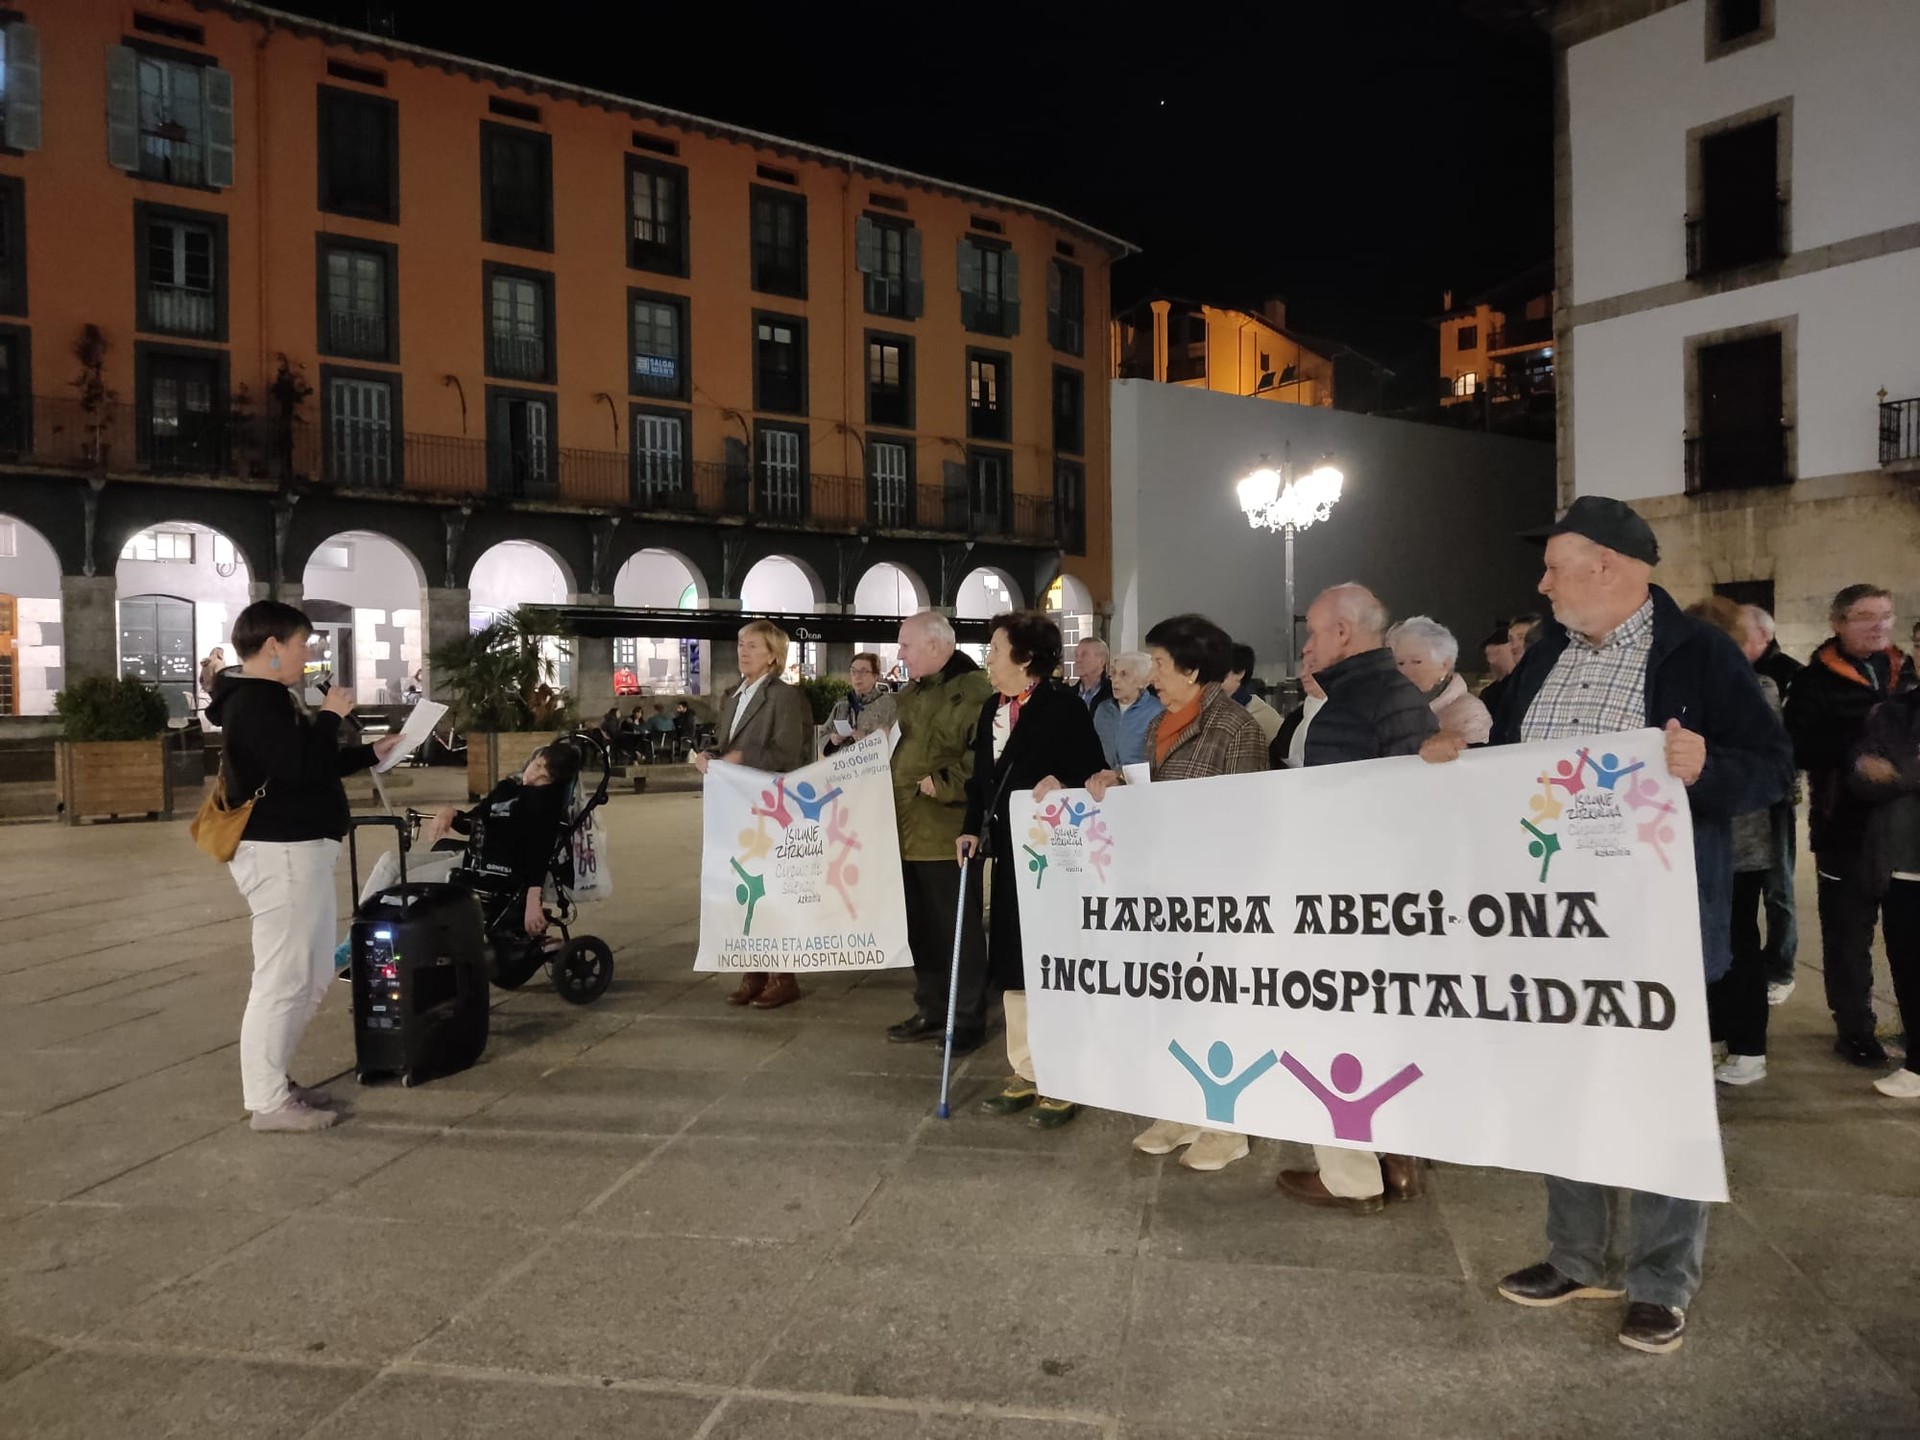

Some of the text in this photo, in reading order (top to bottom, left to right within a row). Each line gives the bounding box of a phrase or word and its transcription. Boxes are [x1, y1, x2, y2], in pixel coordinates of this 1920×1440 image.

[1081, 895, 1275, 934] HARRERA
[725, 932, 876, 951] HARRERA ETA ABEGI ONA
[718, 950, 885, 968] INCLUSIÓN Y HOSPITALIDAD
